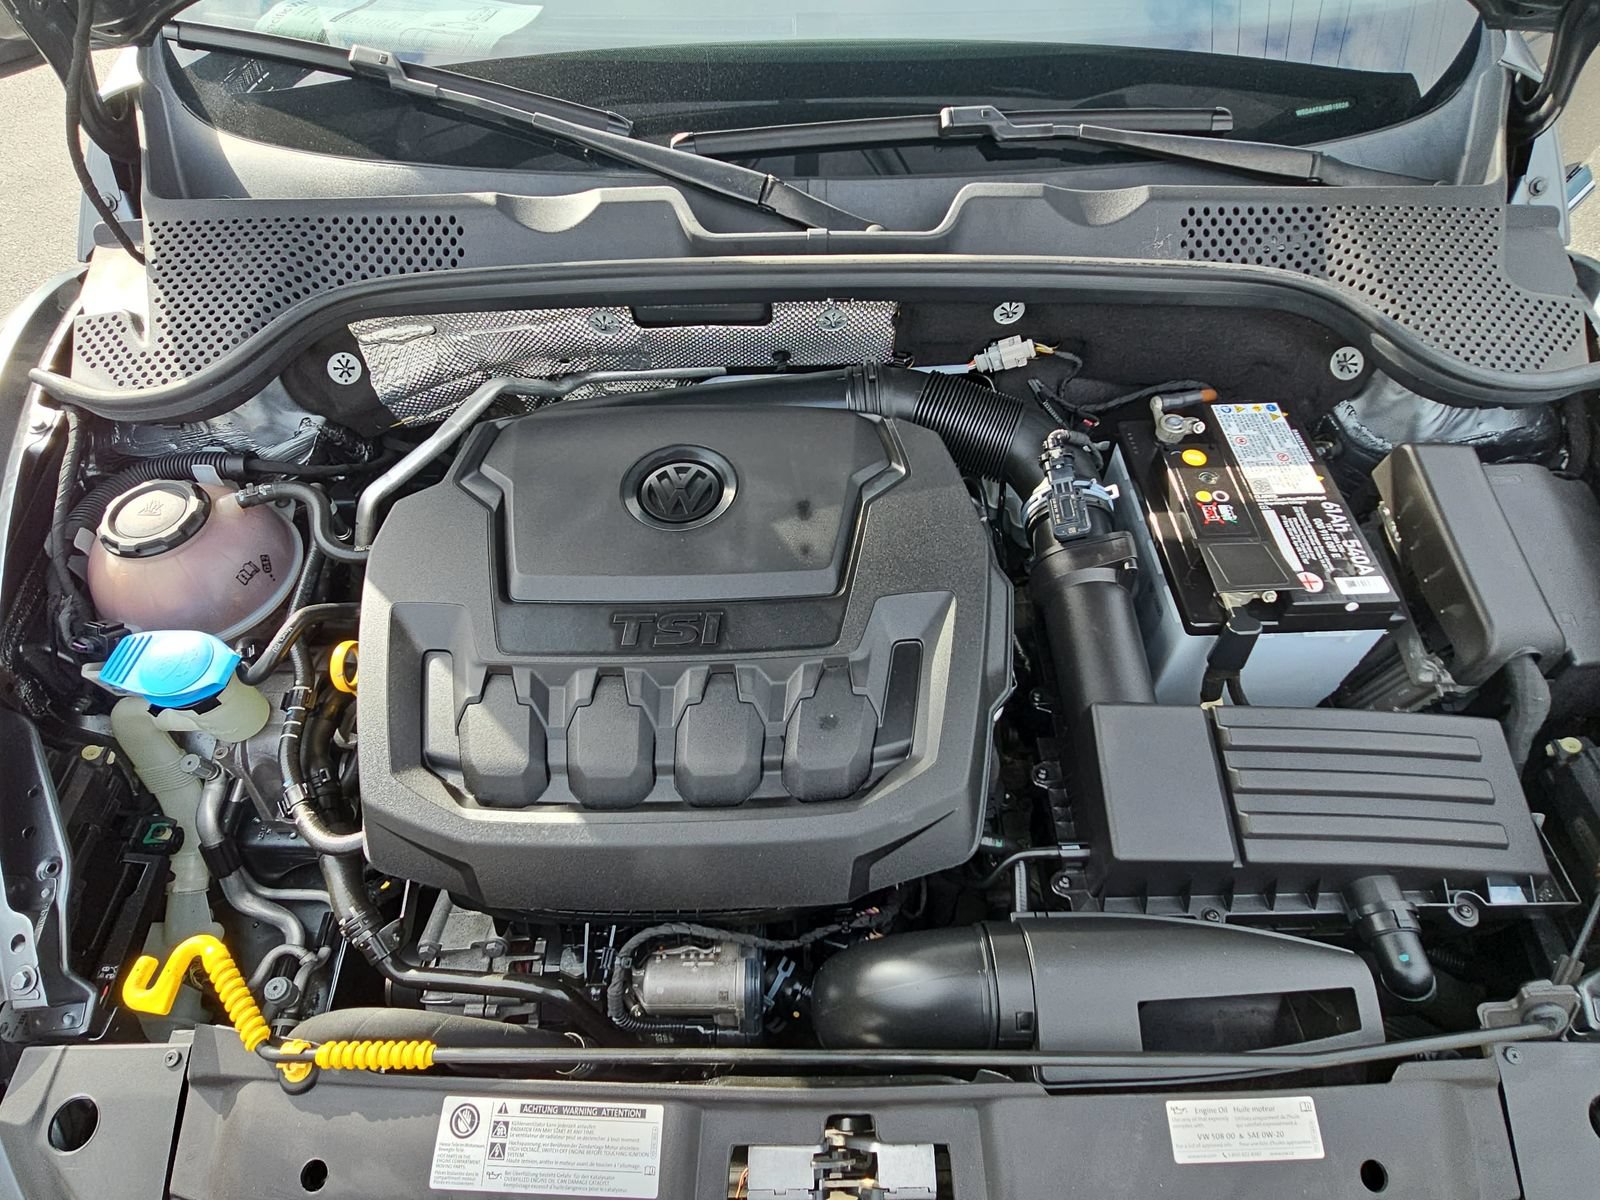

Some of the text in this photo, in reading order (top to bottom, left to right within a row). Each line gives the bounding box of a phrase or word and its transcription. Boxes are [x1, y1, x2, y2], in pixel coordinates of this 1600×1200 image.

[640, 461, 721, 521] VW
[1321, 501, 1351, 533] 61Ah
[1342, 539, 1375, 576] 540A
[612, 611, 724, 646] TSI
[522, 1104, 642, 1118] ACHTUNG WARNING ATTENTION
[1194, 1106, 1216, 1115] Engine
